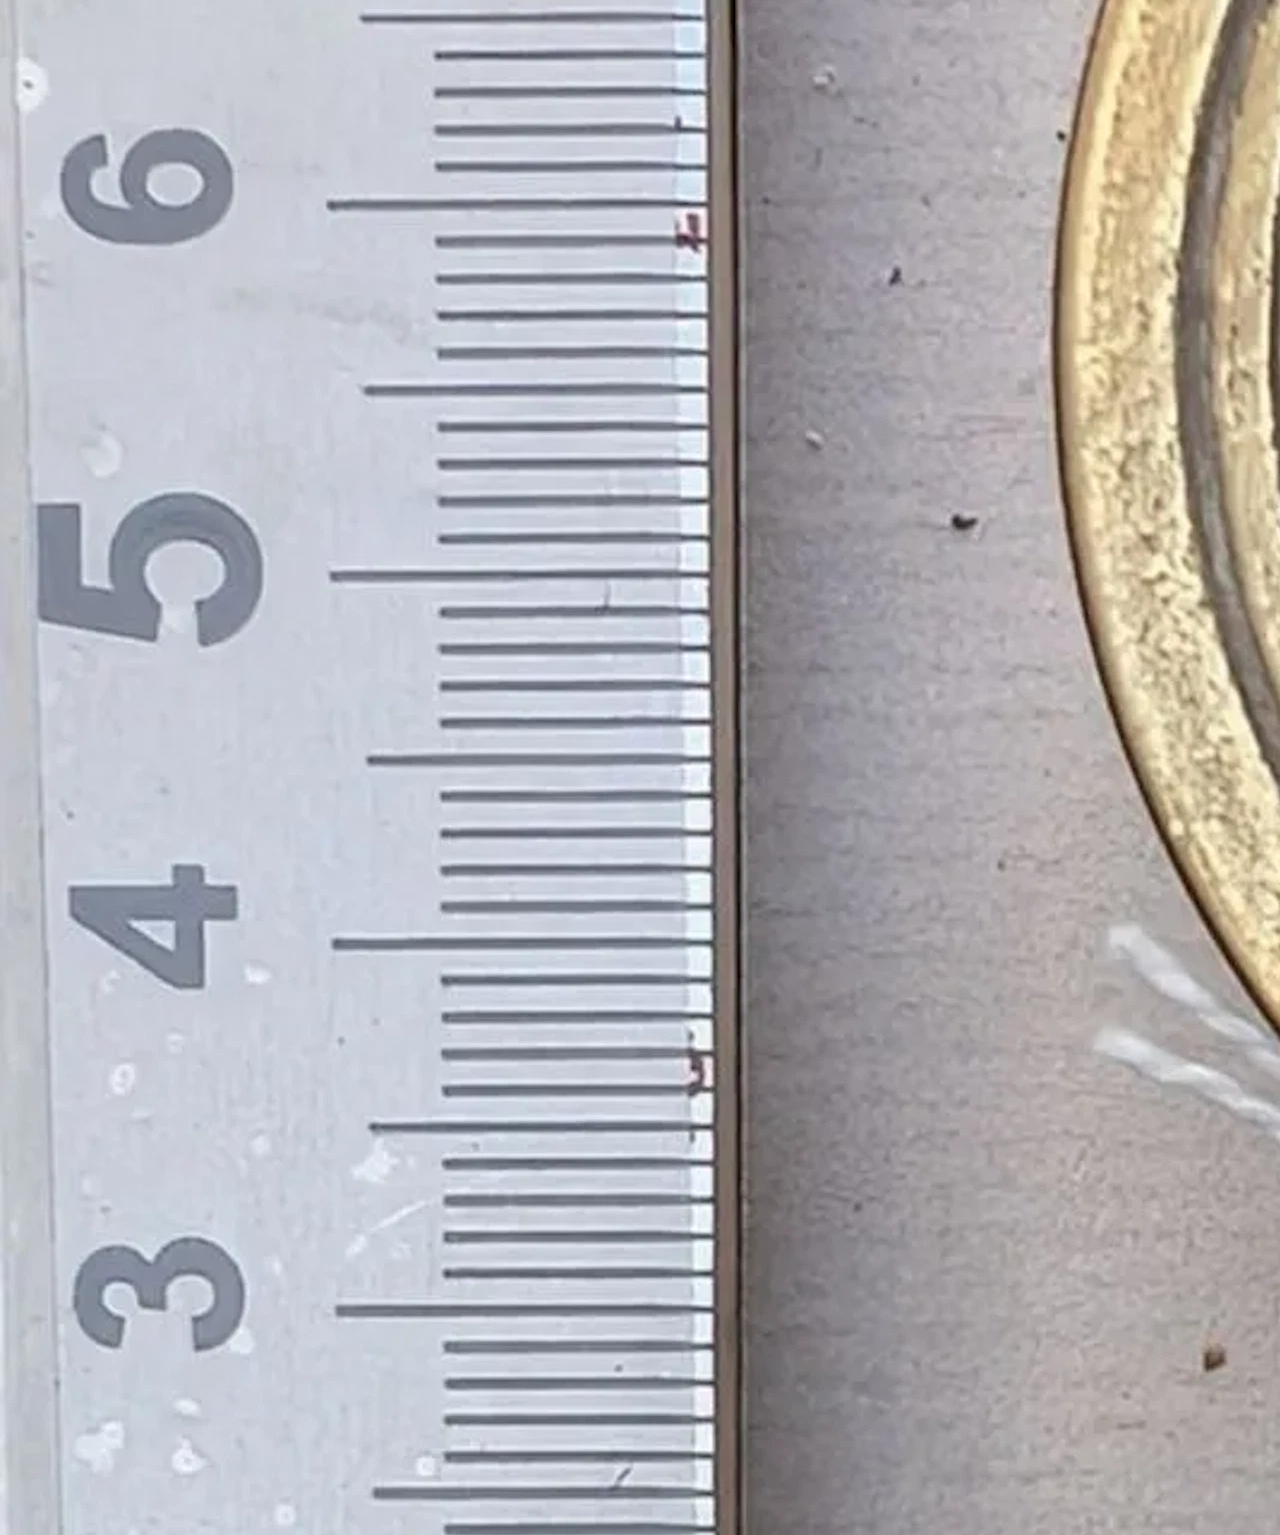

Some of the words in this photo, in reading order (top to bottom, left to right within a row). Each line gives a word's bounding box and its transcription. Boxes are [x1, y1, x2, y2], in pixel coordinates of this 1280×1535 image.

[60, 127, 234, 246] 6
[36, 491, 264, 647] 5
[68, 864, 238, 989] 4
[73, 1235, 246, 1353] 3
